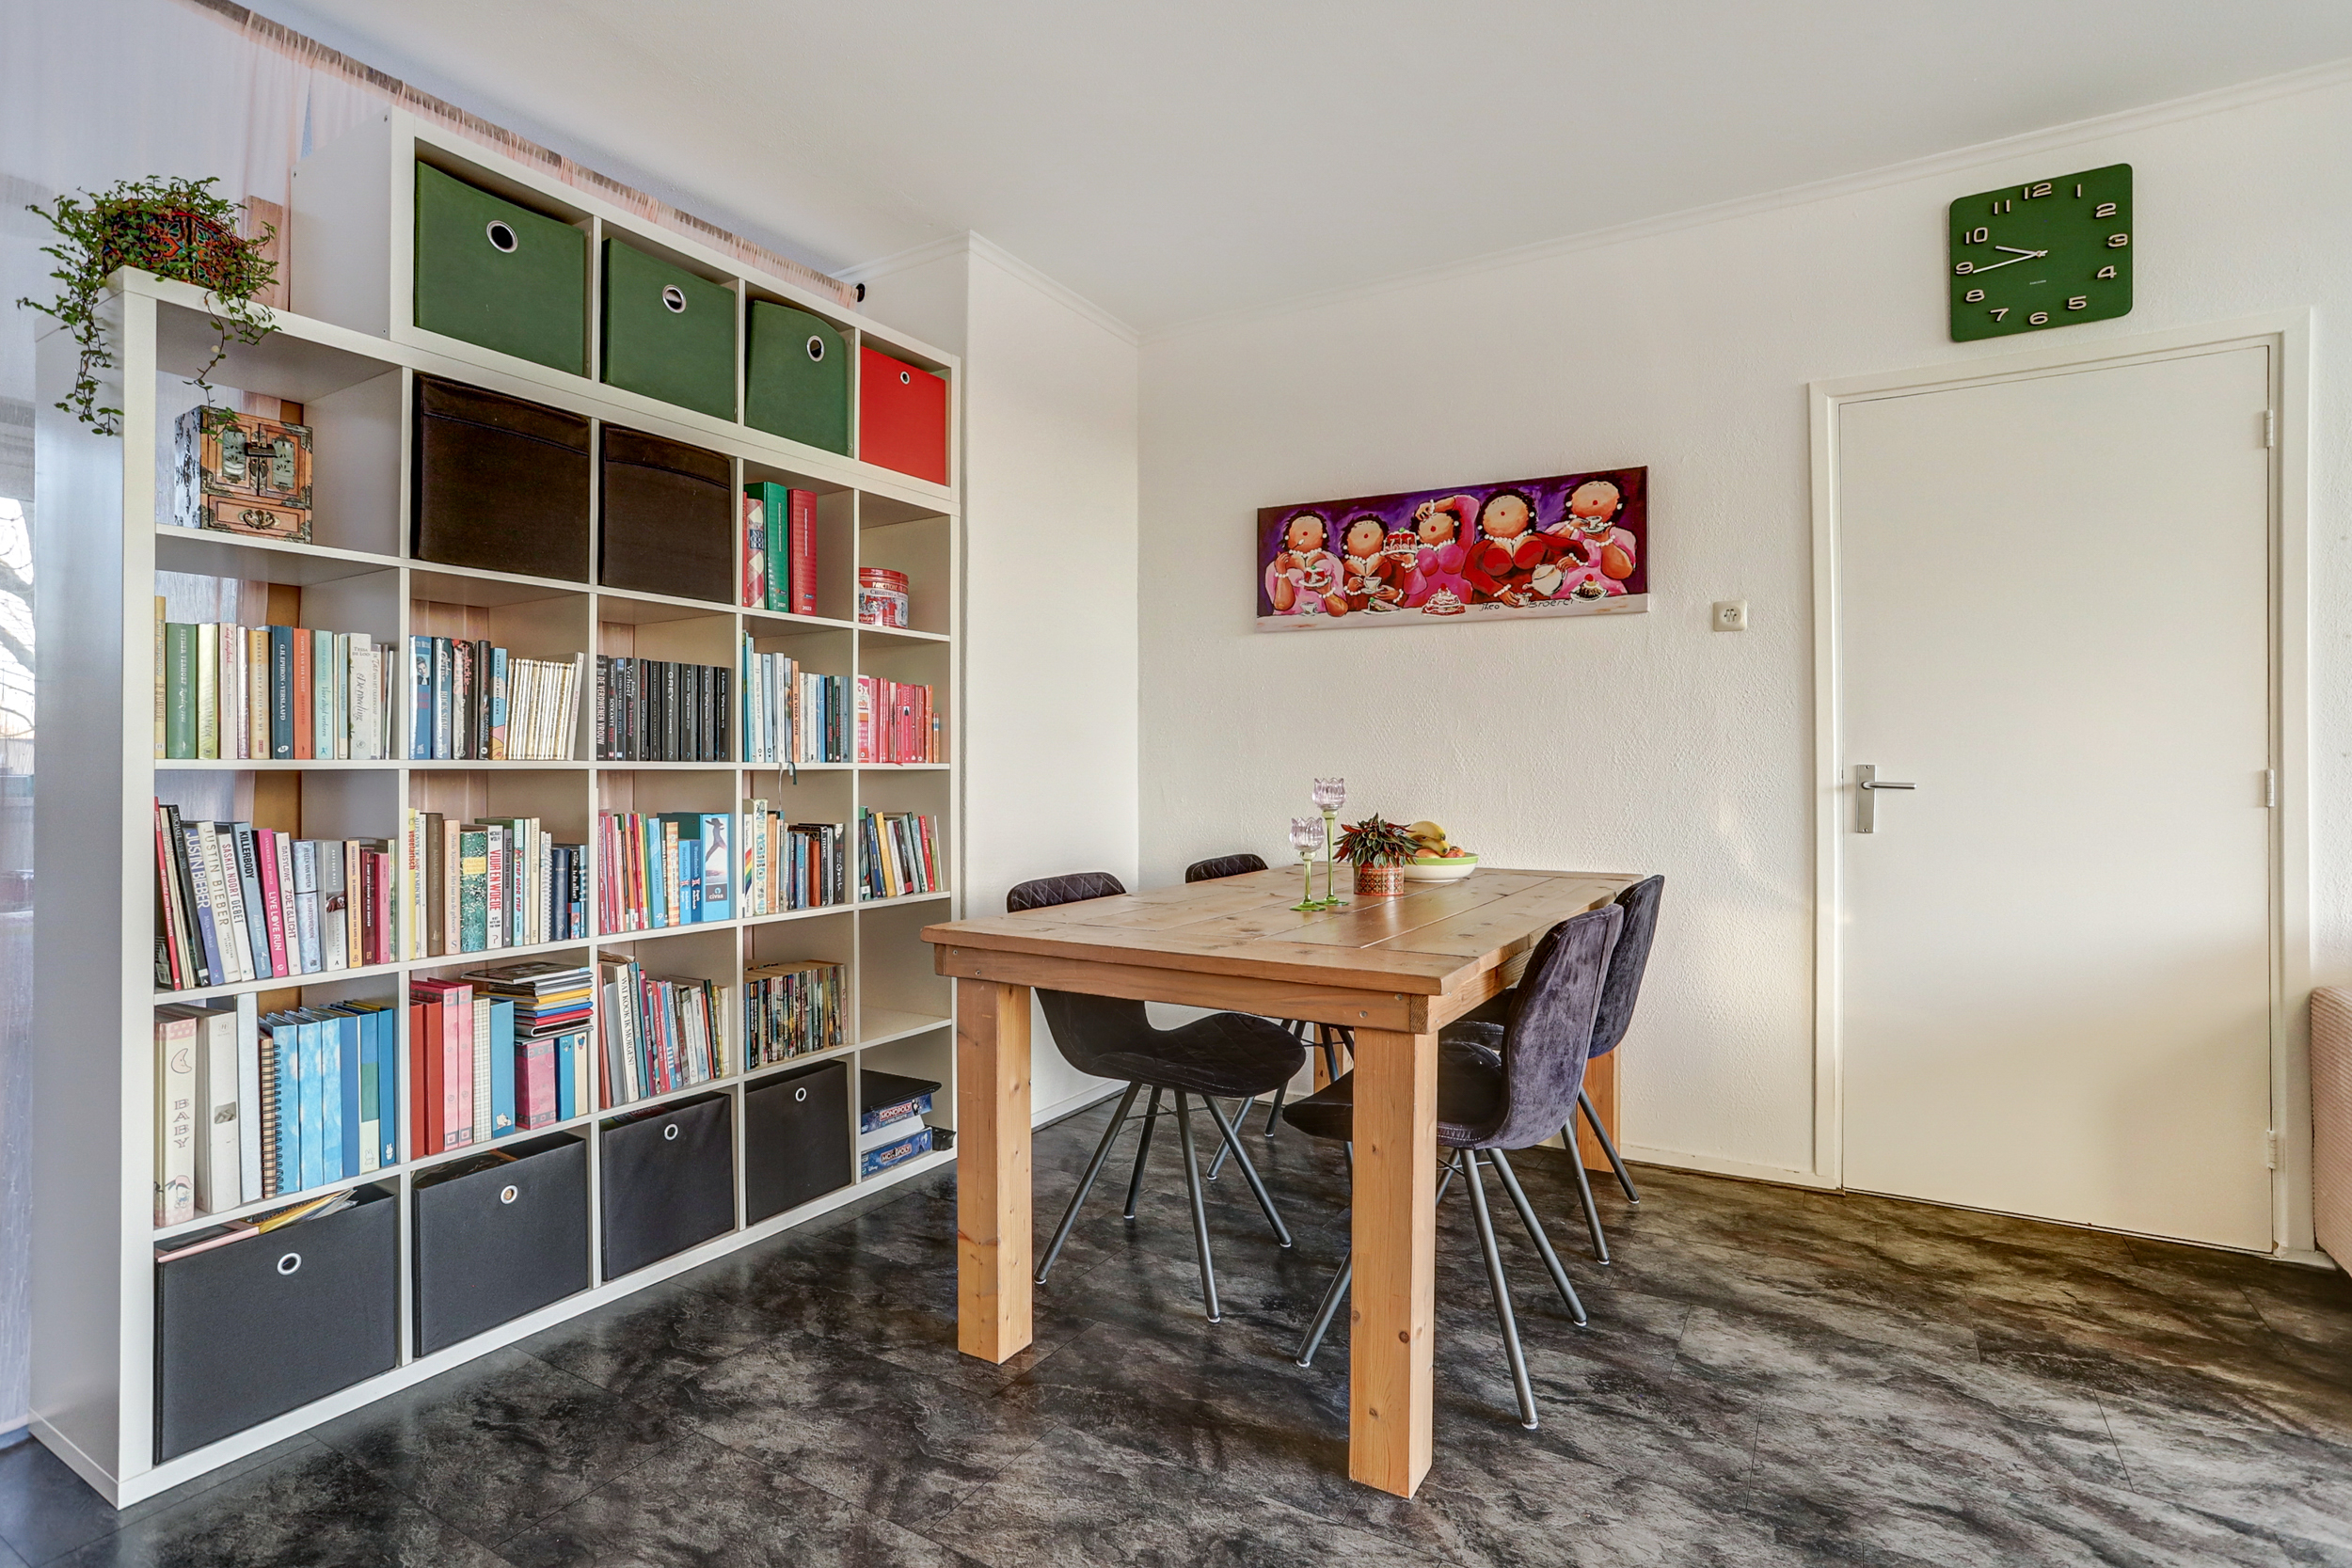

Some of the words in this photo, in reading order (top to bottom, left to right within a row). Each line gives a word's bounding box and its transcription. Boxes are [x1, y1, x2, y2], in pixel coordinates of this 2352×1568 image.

[2024, 182, 2052, 199] 12
[2076, 183, 2082, 198] 1
[1994, 199, 2010, 214] 11
[2095, 202, 2117, 218] 2
[1965, 227, 1988, 245] 10
[2107, 233, 2128, 247] 3
[1955, 261, 1974, 275] 9
[2096, 265, 2117, 279] 4
[1965, 289, 1985, 302] 8
[2068, 295, 2087, 310] 5
[1990, 308, 2009, 322] 7
[2029, 311, 2048, 325] 6
[1479, 603, 1500, 611] Theo
[881, 1103, 911, 1119] MONOPOLY
[174, 1099, 190, 1148] BABY
